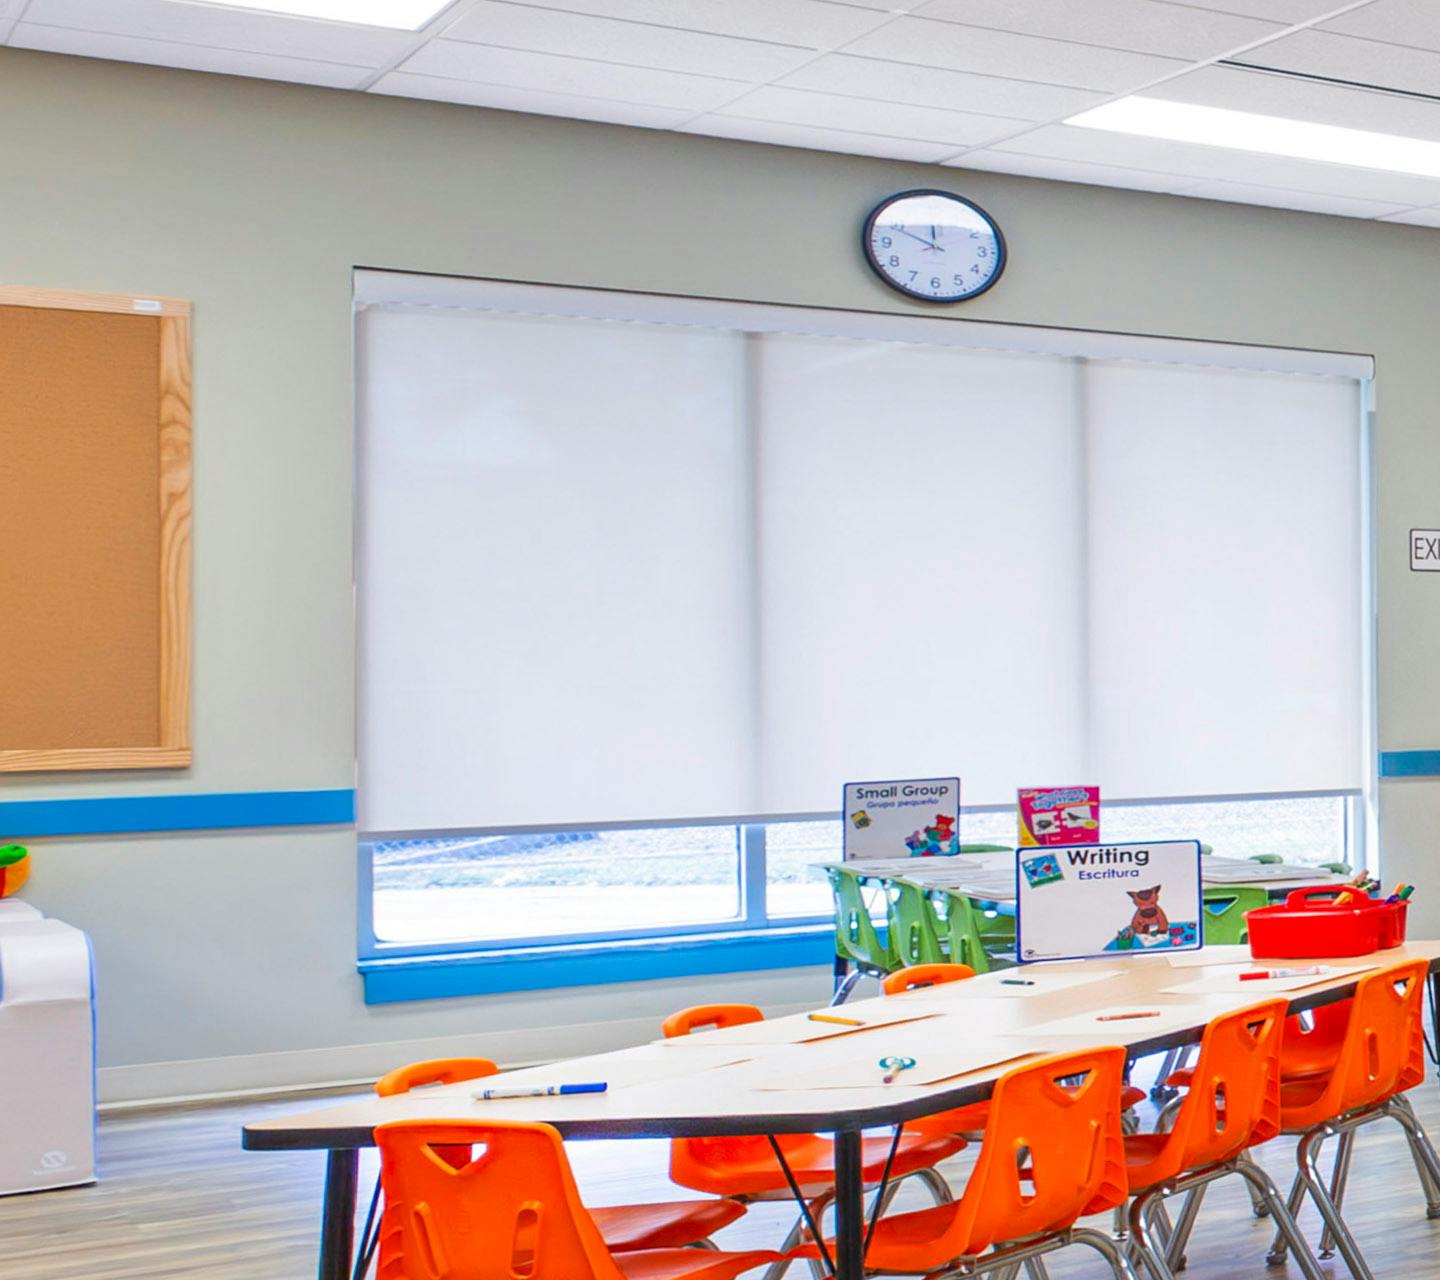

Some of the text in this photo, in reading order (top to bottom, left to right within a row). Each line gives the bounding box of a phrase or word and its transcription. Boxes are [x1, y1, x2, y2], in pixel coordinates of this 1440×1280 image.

[881, 237, 892, 248] 9
[977, 246, 987, 257] 3
[889, 255, 900, 267] 8
[908, 271, 918, 282] 7
[953, 275, 963, 286] 5
[931, 277, 941, 289] 6
[856, 785, 949, 800] Small Group
[866, 798, 939, 808] Grupo pequeño
[1067, 848, 1149, 866] Writing
[1078, 869, 1139, 881] Escritura
